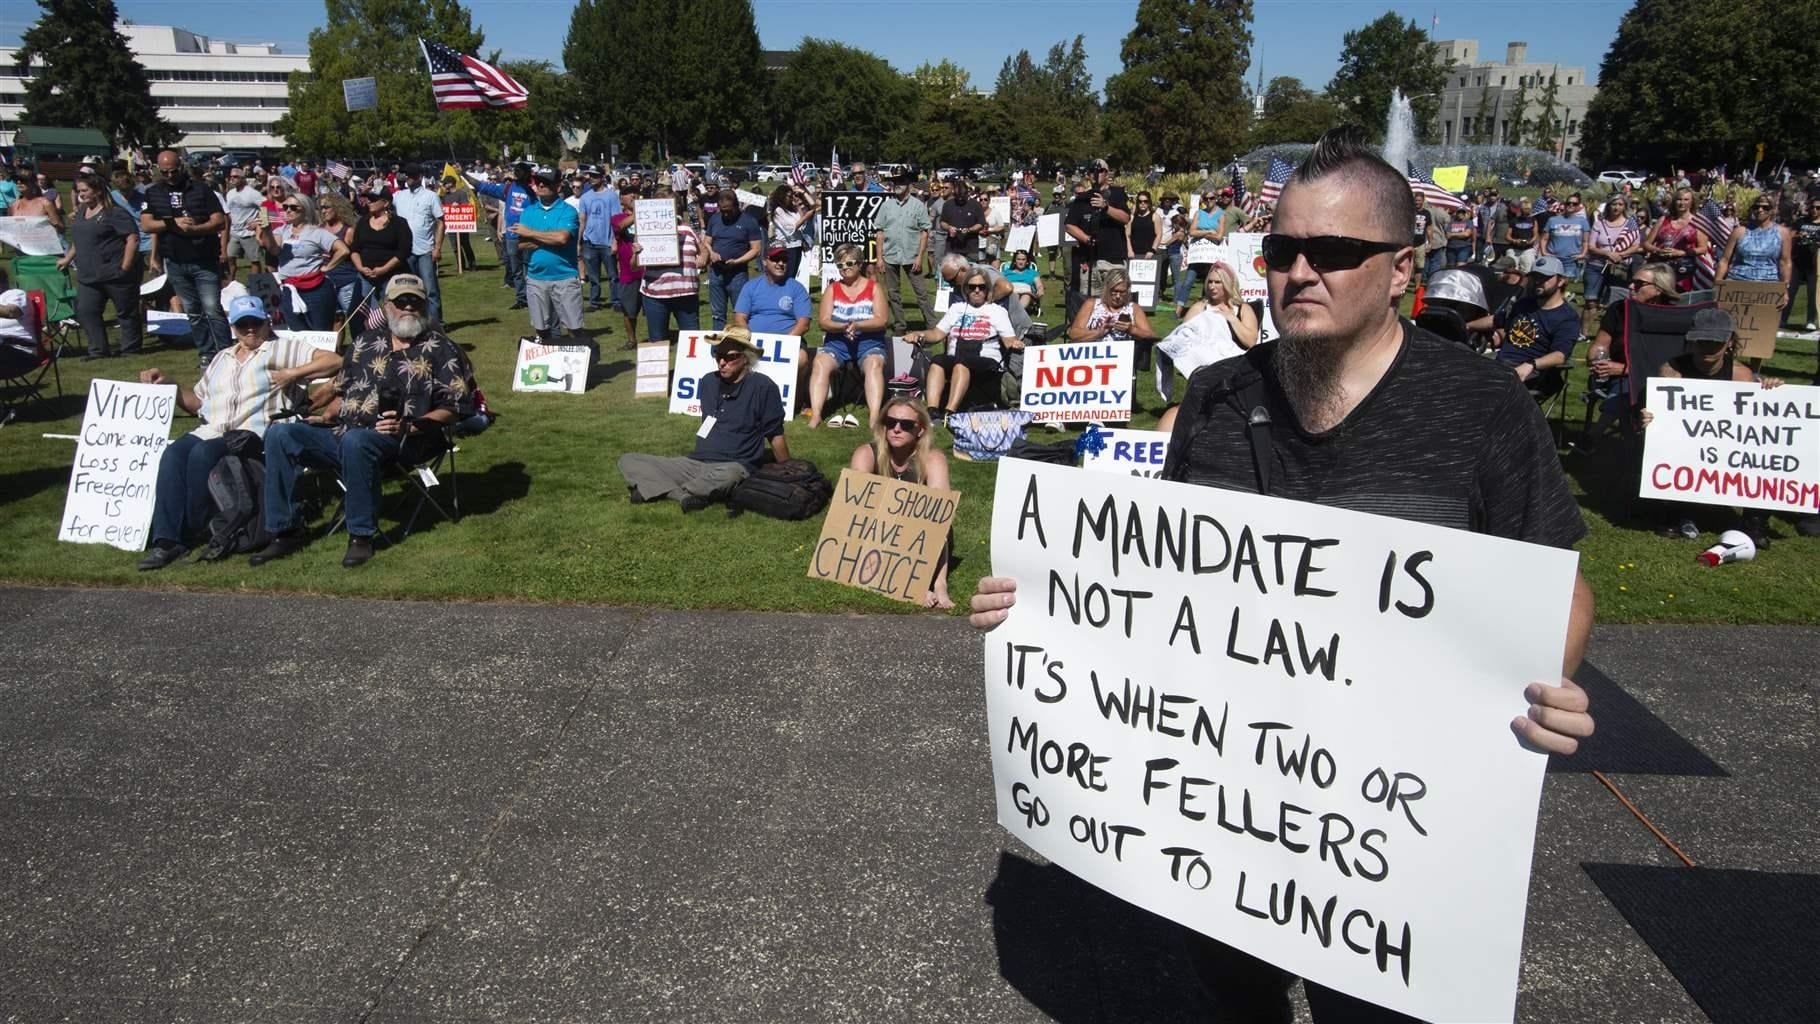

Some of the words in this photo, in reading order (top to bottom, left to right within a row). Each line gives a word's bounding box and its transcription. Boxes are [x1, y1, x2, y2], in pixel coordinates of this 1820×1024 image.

[638, 210, 650, 220] IS
[653, 208, 675, 220] THE
[825, 196, 889, 218] 17.79
[640, 221, 673, 231] VIRUS
[822, 229, 865, 246] injuries
[1240, 288, 1269, 297] EMEMB
[1714, 284, 1784, 304] INTEGRITY
[1730, 303, 1752, 315] AT
[525, 345, 556, 361] RECALL
[686, 336, 699, 358] I
[1038, 349, 1046, 363] I
[1059, 345, 1118, 360] WILL
[1035, 364, 1118, 388] NOT
[92, 382, 174, 424] Viruses
[1024, 390, 1128, 406] COMPLY
[1656, 385, 1715, 411] THE
[1733, 391, 1820, 420] FINAL
[1032, 409, 1132, 422] OPTHEMANDATE
[84, 424, 127, 446] Come
[130, 433, 153, 449] and
[1682, 418, 1802, 447] VARIANT
[79, 453, 119, 472] Loss
[129, 451, 150, 472] of
[1700, 446, 1719, 464] IS
[1727, 450, 1800, 473] CALLED
[74, 472, 150, 500] Freedom
[1651, 462, 1820, 509] COMMUNISM
[844, 477, 882, 510] WE
[887, 487, 955, 524] SHOULD
[847, 513, 904, 547] HAVE
[907, 529, 927, 555] A
[1017, 473, 1047, 548] A
[1072, 493, 1340, 597] MANDATE
[1378, 549, 1435, 618] IS
[815, 537, 929, 600] CHOICE
[1048, 568, 1153, 638] NOT
[1168, 594, 1202, 654] A
[1226, 605, 1353, 686] LAW.
[1006, 641, 1068, 703] IT'S
[1090, 670, 1229, 757] WHEN
[1247, 721, 1337, 788] TWO
[1361, 766, 1428, 837] OR
[1007, 715, 1113, 793] MORE
[1142, 757, 1390, 883] FELLERS
[1012, 781, 1050, 829] GO
[1068, 813, 1146, 863] OUT
[1160, 846, 1212, 890] TO
[1234, 870, 1411, 988] LUNCH
